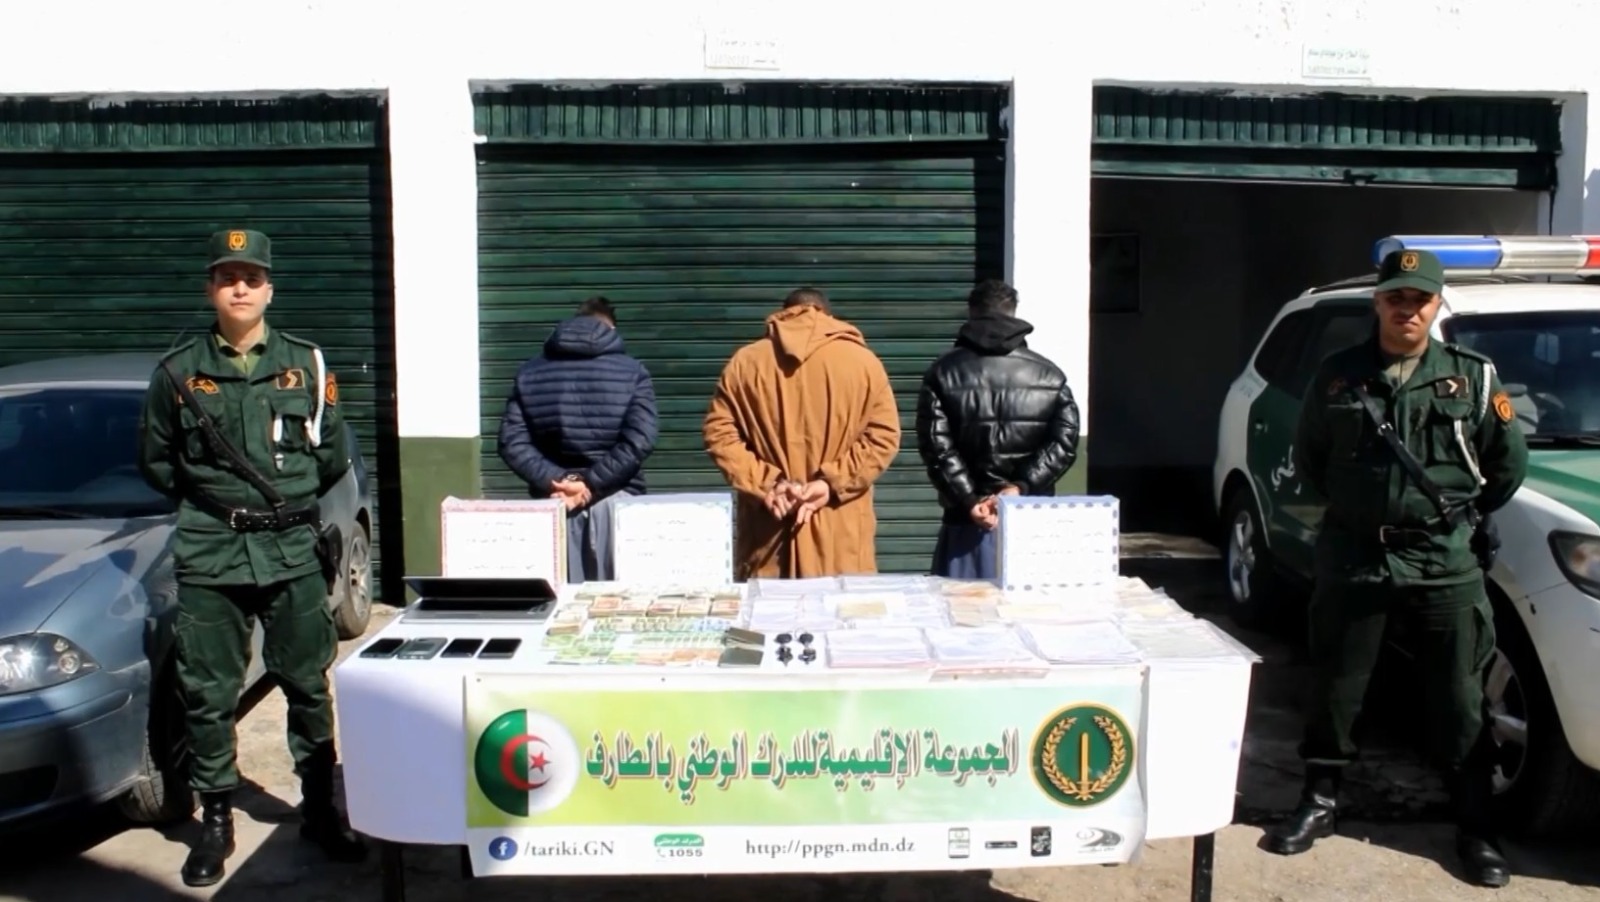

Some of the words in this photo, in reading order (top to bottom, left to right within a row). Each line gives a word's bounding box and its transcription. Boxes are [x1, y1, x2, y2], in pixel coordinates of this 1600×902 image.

[586, 730, 675, 792] بالطارف
[677, 731, 747, 804] الوطني
[750, 730, 819, 789] للدرك
[820, 727, 920, 791] الإقليمية
[924, 727, 1019, 787] المجموعة
[523, 840, 615, 857] /tariki.GN
[669, 848, 703, 858] 1055
[745, 837, 915, 859] http://ppgn.mdn.dz
